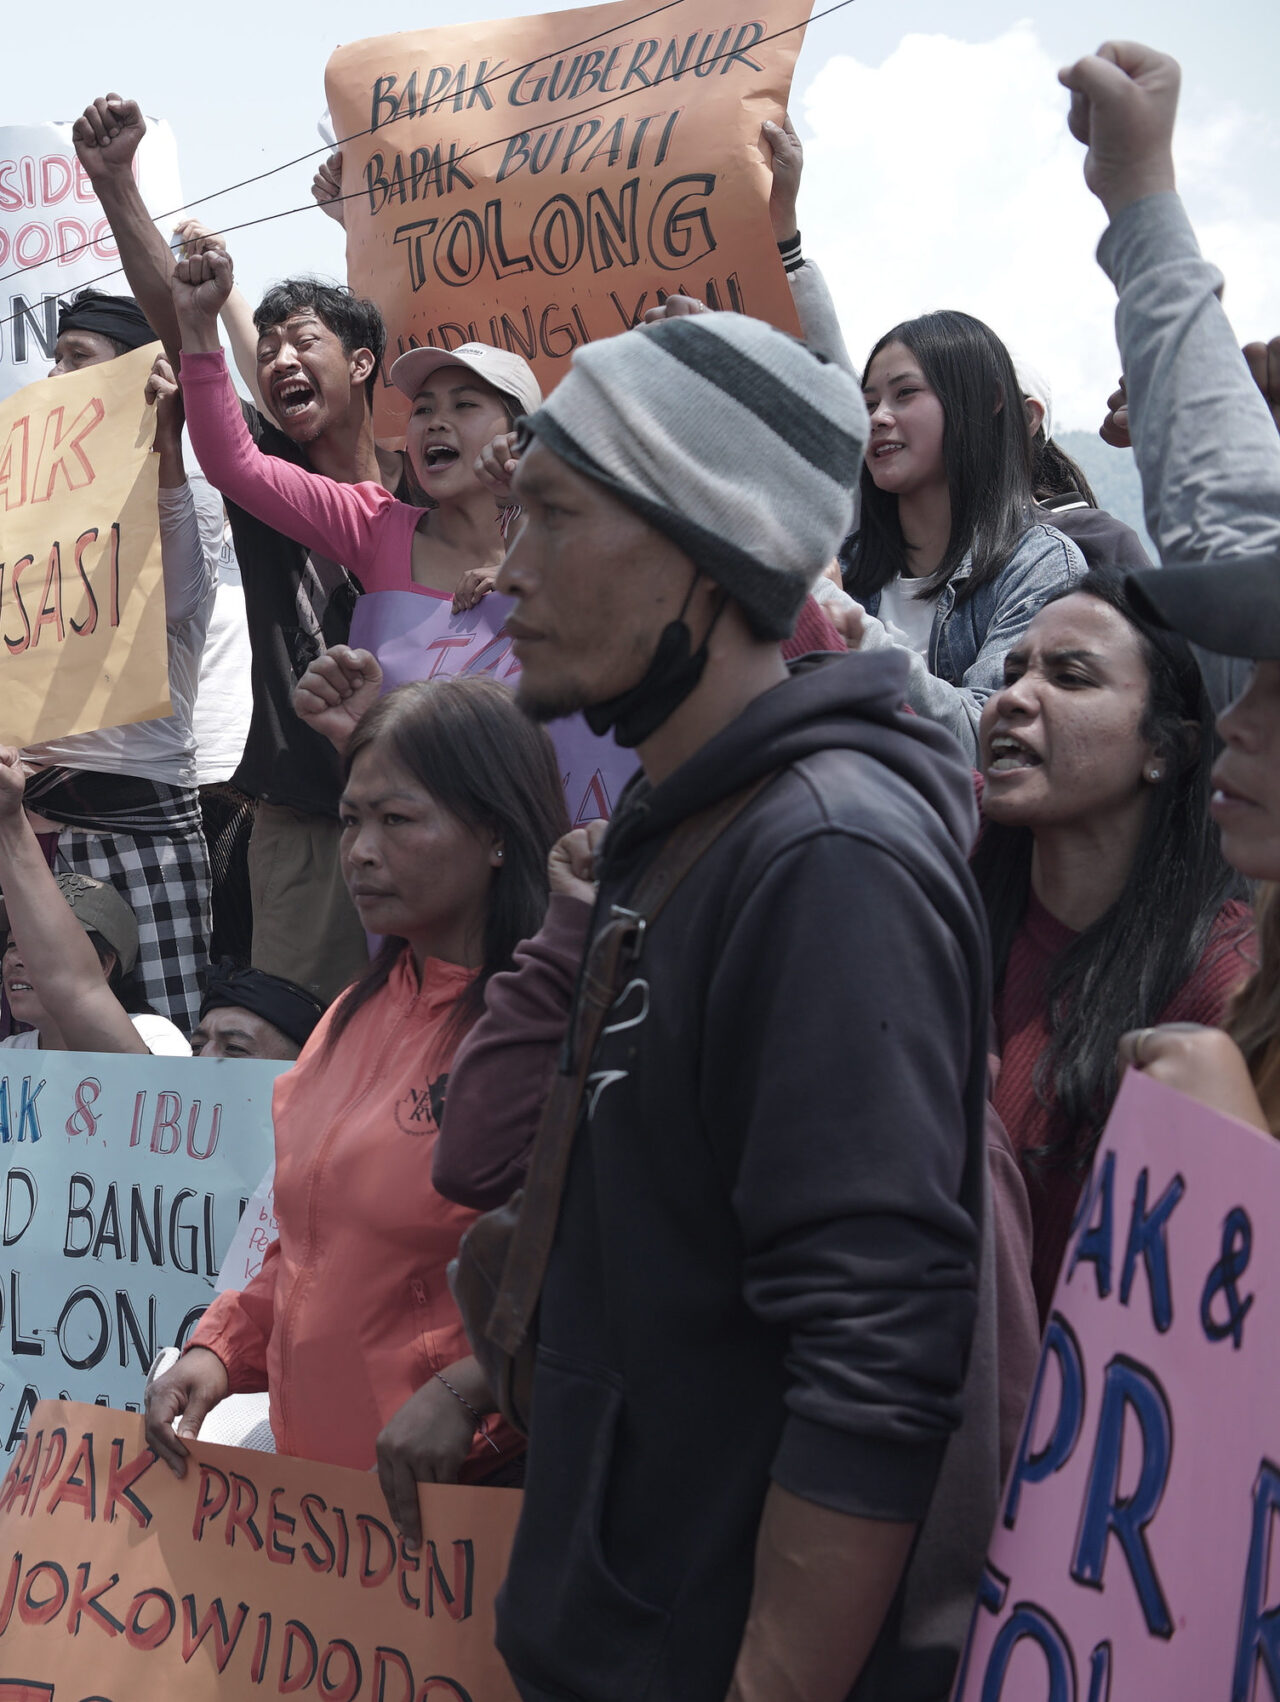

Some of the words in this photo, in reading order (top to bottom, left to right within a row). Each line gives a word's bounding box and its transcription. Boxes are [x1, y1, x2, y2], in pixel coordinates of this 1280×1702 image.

[369, 57, 509, 134] BAPAK
[507, 20, 767, 107] GUBERNUR
[363, 137, 478, 216] BAPAK
[495, 105, 686, 184] BUPATI
[393, 173, 718, 293] TOLONG
[64, 1076, 104, 1138] &
[129, 1090, 223, 1160] IBU
[192, 1462, 473, 1622] PRESIDEN
